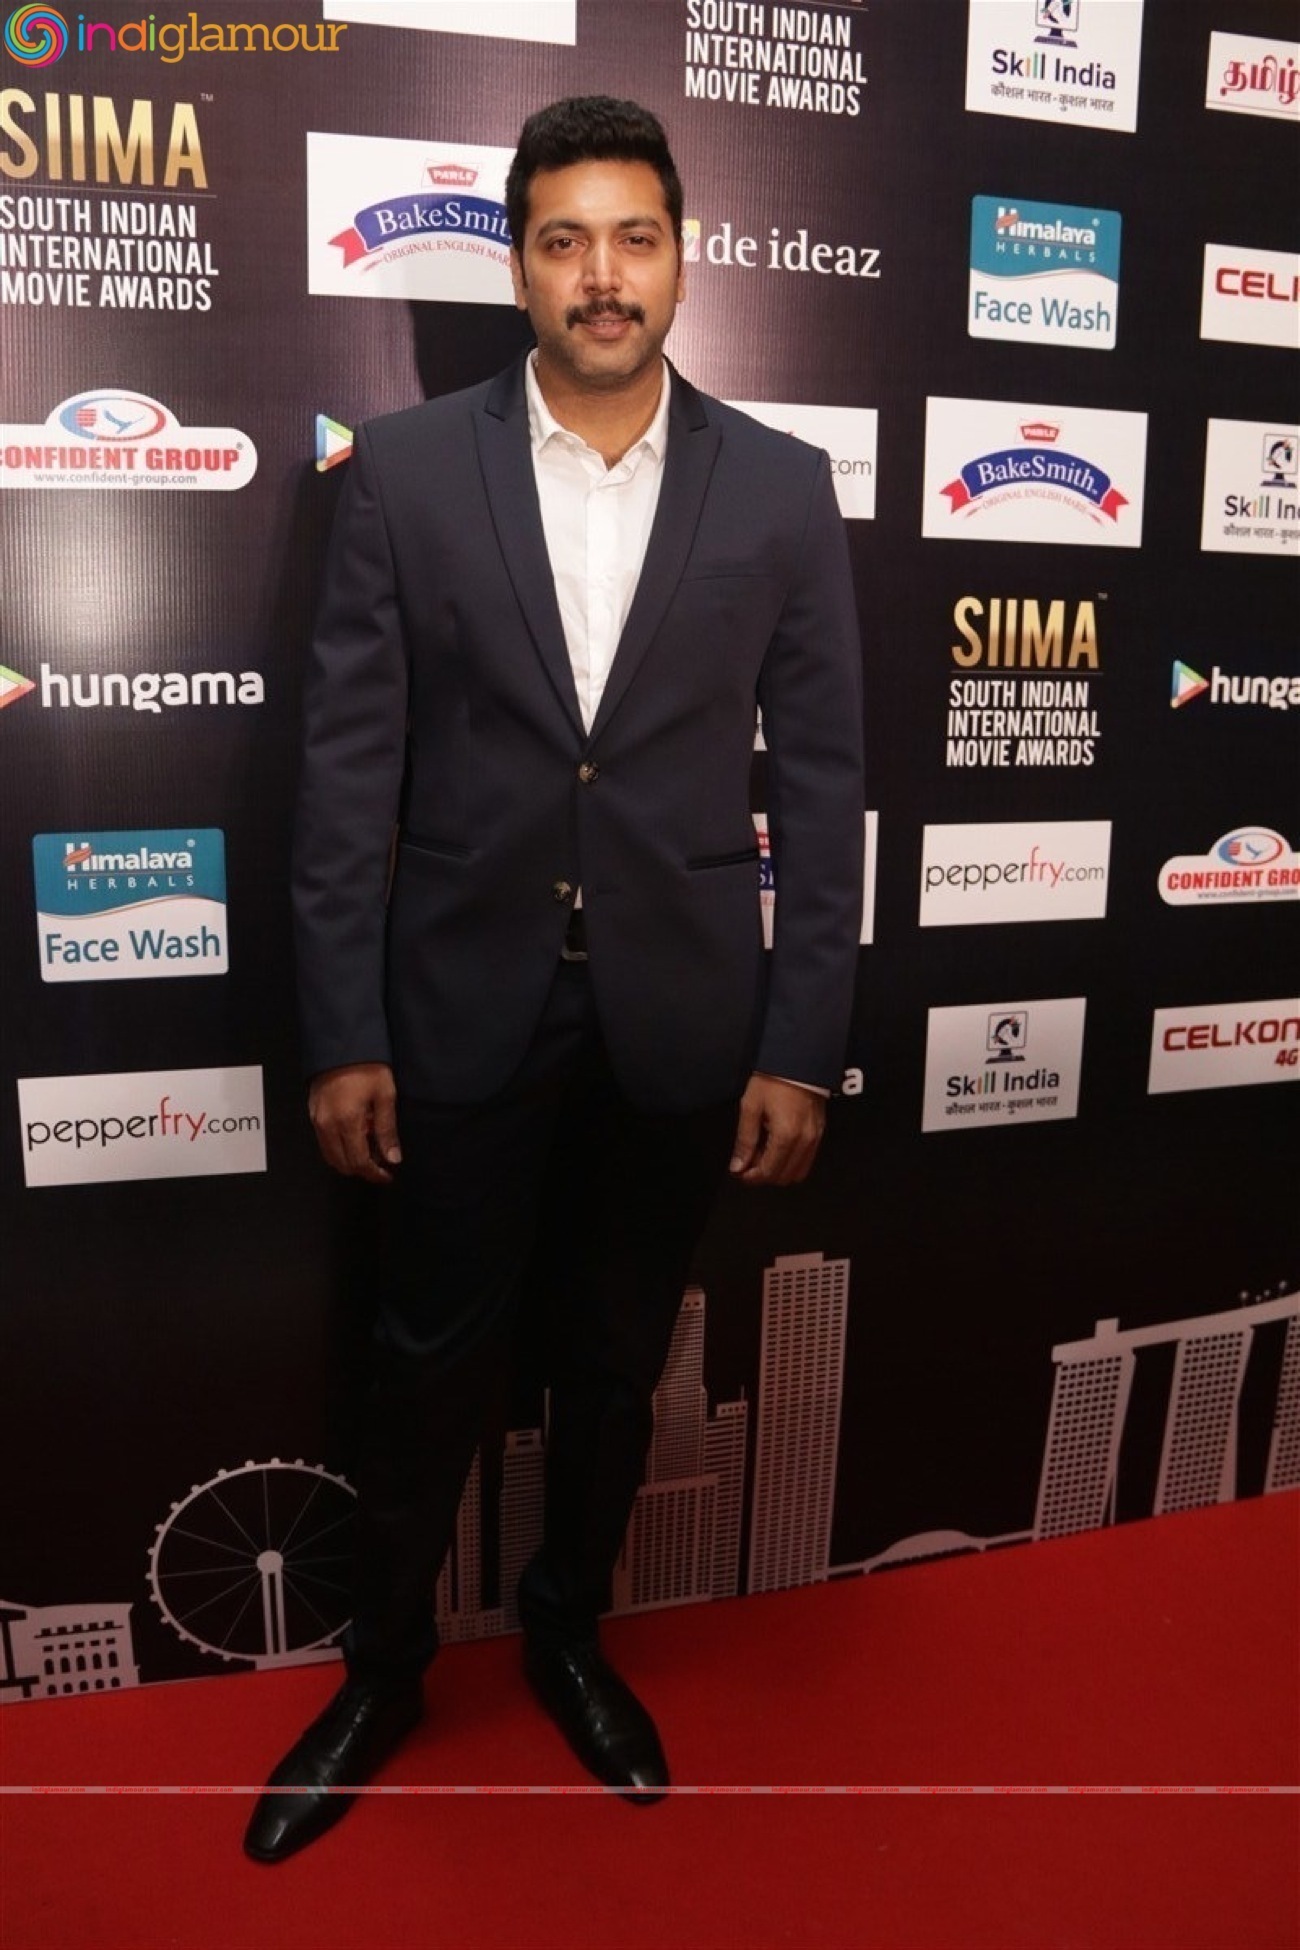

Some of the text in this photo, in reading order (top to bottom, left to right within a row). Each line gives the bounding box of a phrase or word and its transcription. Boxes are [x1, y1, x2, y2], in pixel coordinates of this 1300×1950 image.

[687, 0, 850, 47] SOUTH INDIAN
[685, 32, 868, 83] INTERNATIONAL
[992, 49, 1116, 89] Skill India
[685, 67, 860, 116] MOVIE AWARDS
[1220, 55, 1300, 104] தமிழ்
[0, 88, 208, 189] SIIMA
[0, 195, 196, 237] SOUTH INDIAN
[375, 201, 512, 240] BakeSmit
[995, 207, 1095, 245] Himalaya
[0, 233, 219, 275] INTERNATIONAL
[437, 240, 485, 255] ENGLISH
[706, 223, 881, 278] de ideaz
[996, 242, 1096, 263] HERBALS
[0, 271, 212, 312] MOVIE AWARDS
[974, 291, 1111, 332] Face Wash
[34, 472, 197, 485] www.confident-group.com
[146, 449, 239, 471] GROUP
[977, 455, 1095, 492] BakeSmith
[1225, 495, 1300, 520] Skill In
[952, 595, 1100, 668] SIIMA
[40, 663, 265, 713] hungama
[949, 679, 1089, 707] SOUTH INDIAN
[1211, 666, 1300, 710] hunga
[947, 710, 1101, 737] INTERNATIONAL
[946, 738, 1095, 767] MOVIE AWARDS
[64, 843, 192, 871] Himalaya
[925, 846, 1104, 892] pepperfry.com
[68, 875, 194, 890] HERBALS
[1167, 870, 1264, 890] CONFIDENT
[46, 926, 221, 964] Face Wash
[1275, 1048, 1298, 1066] 4G
[946, 1068, 1060, 1097] Skill India
[27, 1097, 260, 1151] pepperfry.com
